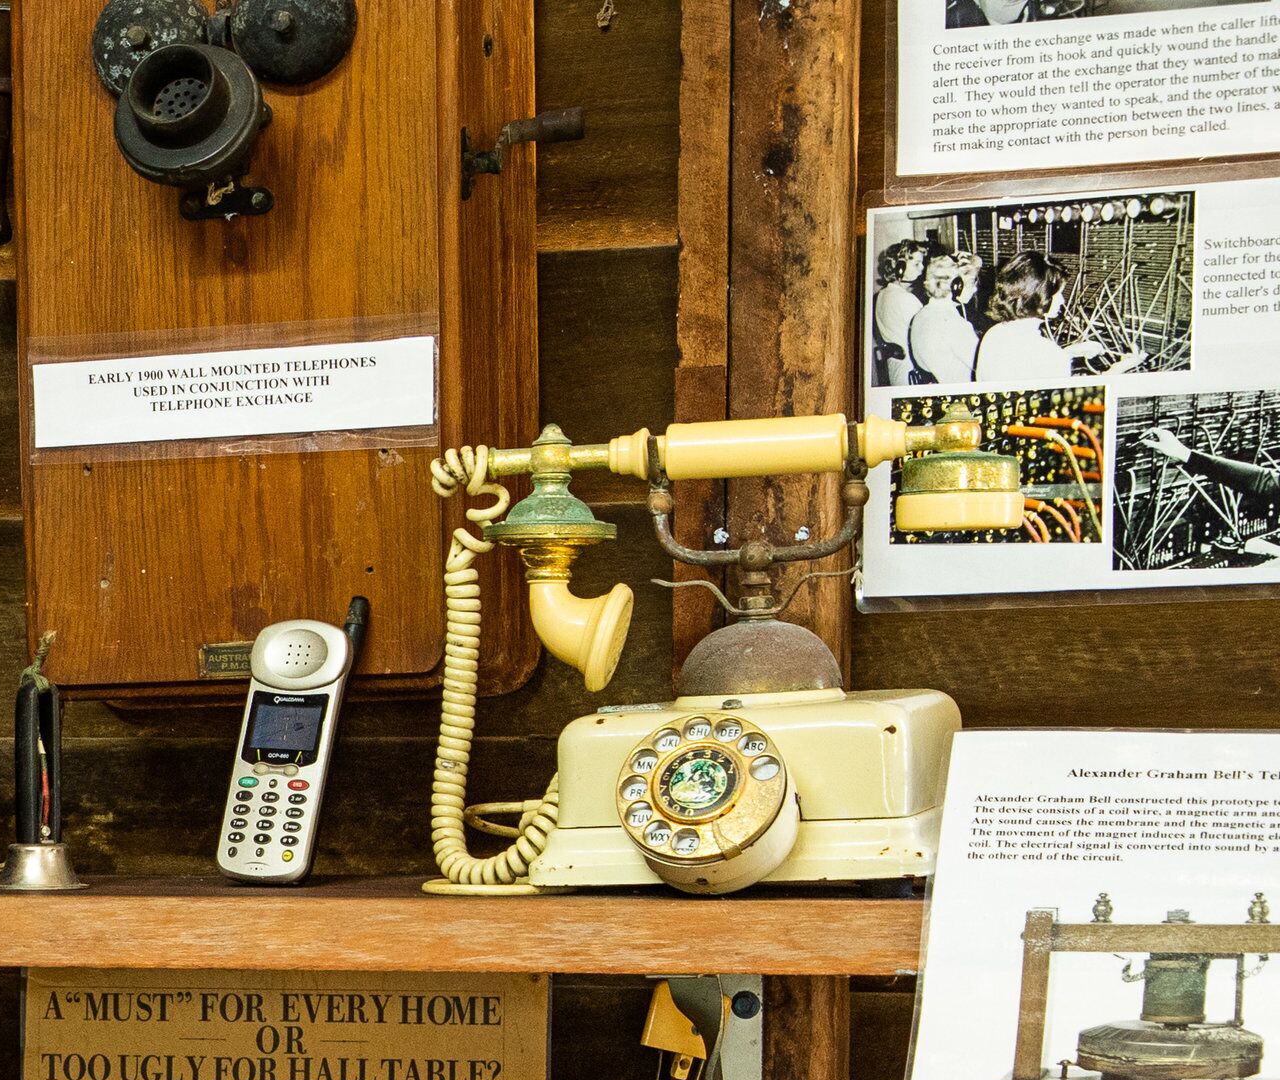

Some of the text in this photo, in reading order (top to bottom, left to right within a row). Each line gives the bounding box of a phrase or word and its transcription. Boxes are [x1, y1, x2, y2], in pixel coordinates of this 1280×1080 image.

[932, 18, 1256, 55] Contact with the exchange was made when the caller
[1204, 253, 1260, 266] caller for
[1203, 269, 1265, 283] connected
[1202, 304, 1269, 315] number on
[88, 357, 376, 385] EARLY 1900 WALL MOUNTED TELEPHONES
[133, 375, 329, 398] USED IN CONJUNCTION WITH
[149, 392, 312, 412] TELEPHONE EXCHANGE
[744, 742, 764, 752] ABC
[1066, 768, 1142, 779] Alexander
[1146, 769, 1207, 779] Graham
[967, 851, 984, 860] the
[988, 851, 1016, 860] other
[1022, 852, 1042, 860] end
[1046, 852, 1058, 860] of
[1061, 852, 1078, 861] the
[198, 994, 266, 1024] FOR
[280, 994, 391, 1024] EVERY
[399, 996, 501, 1026] HOME
[255, 1026, 307, 1054] OR
